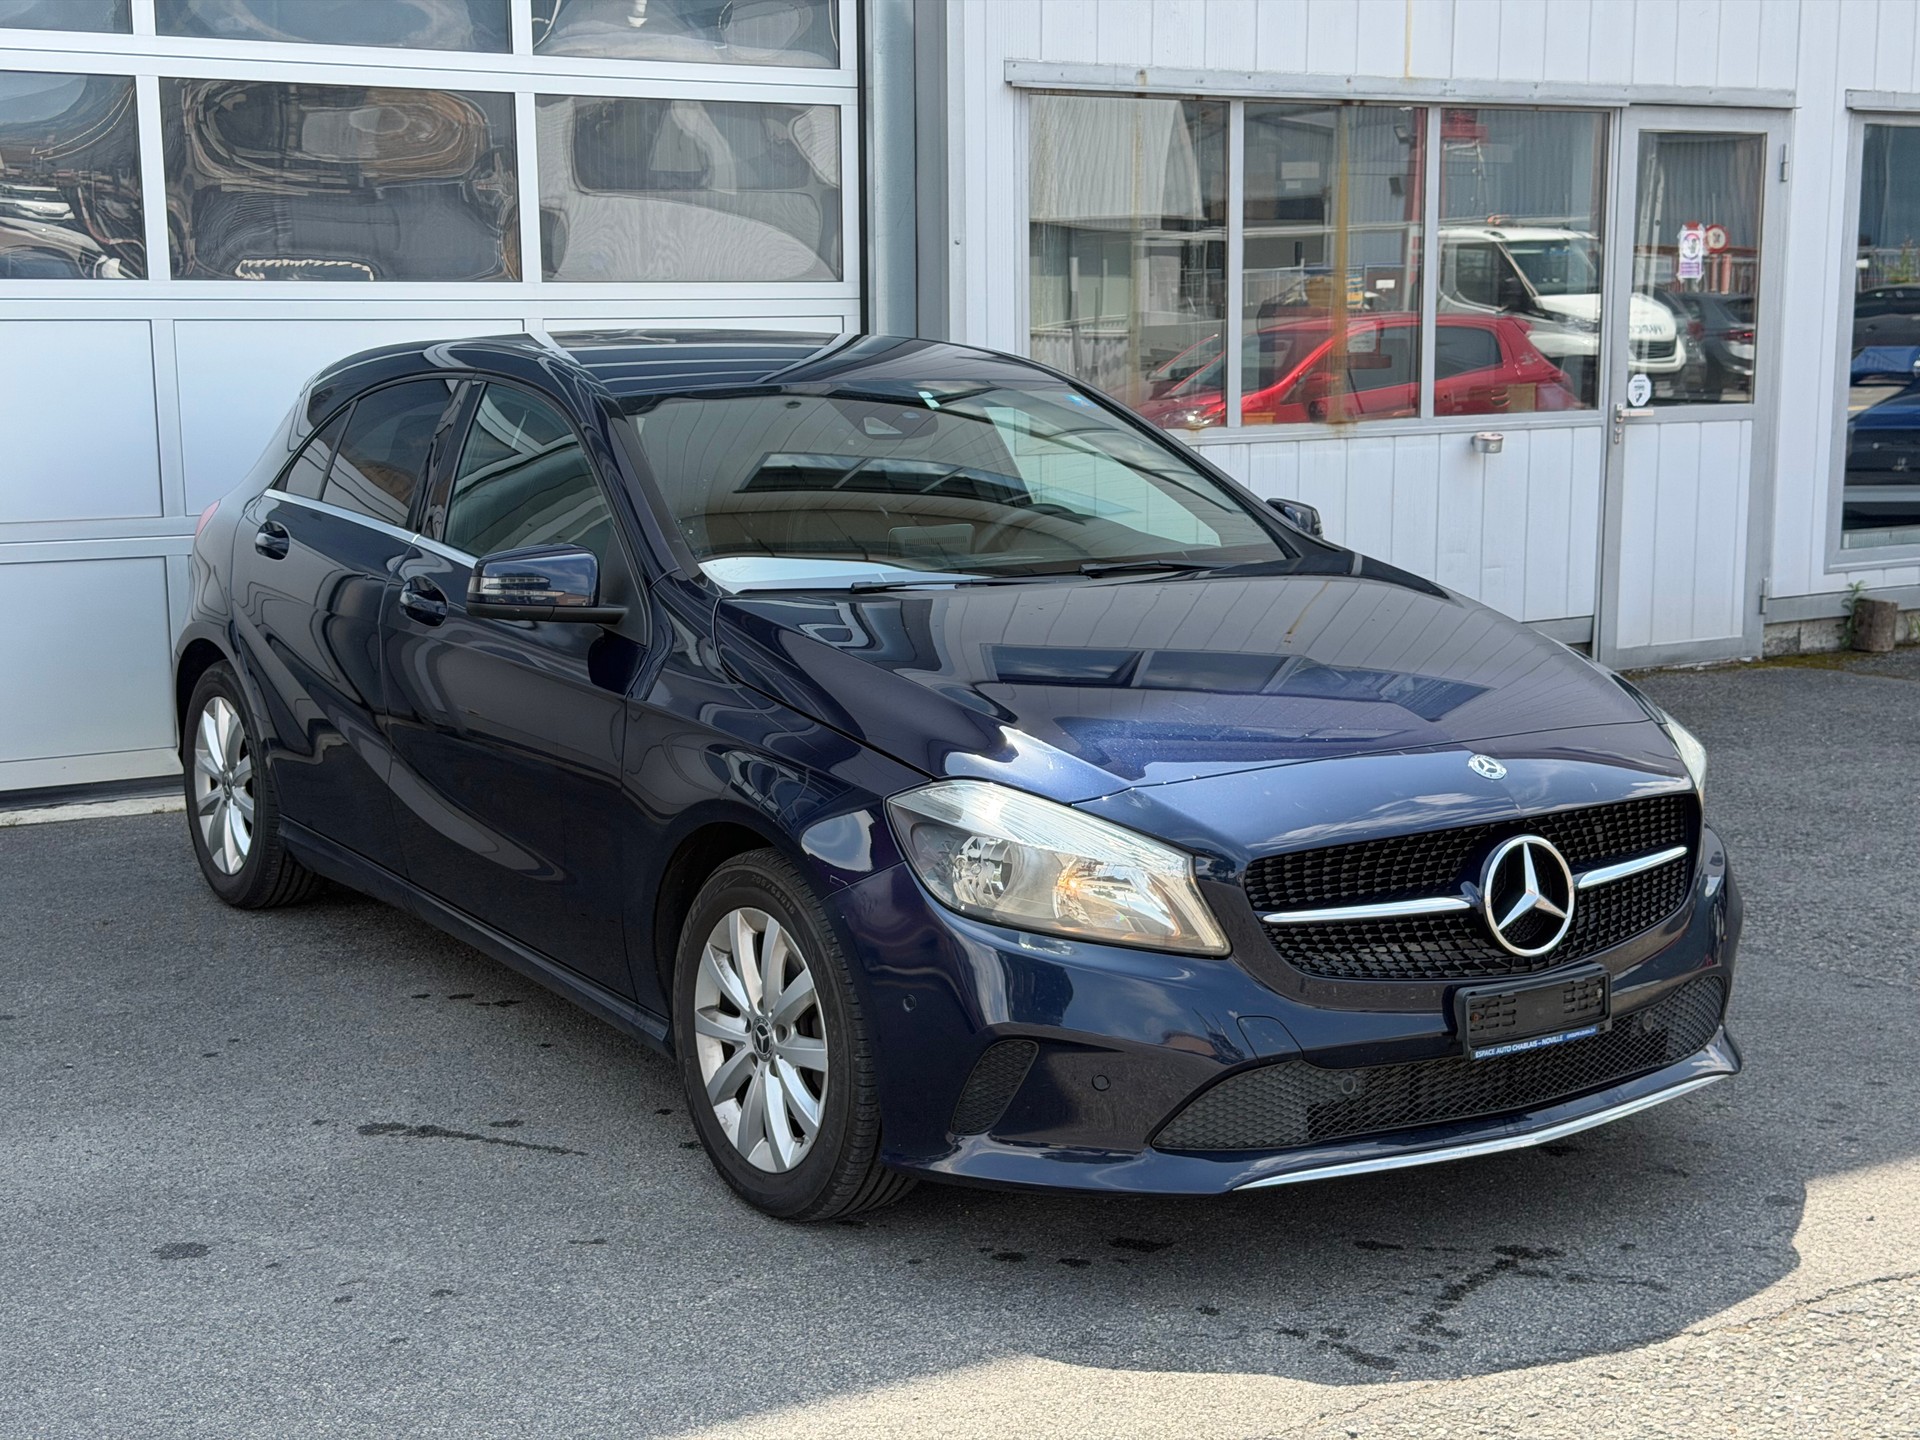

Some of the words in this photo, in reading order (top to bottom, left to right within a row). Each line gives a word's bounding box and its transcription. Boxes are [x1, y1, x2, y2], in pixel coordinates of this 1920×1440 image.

[1475, 1048, 1495, 1059] ESPACE
[1496, 1045, 1512, 1054] AUTO
[1512, 1040, 1537, 1051] CHABLAIS
[1541, 1034, 1563, 1046] NOVILLE
